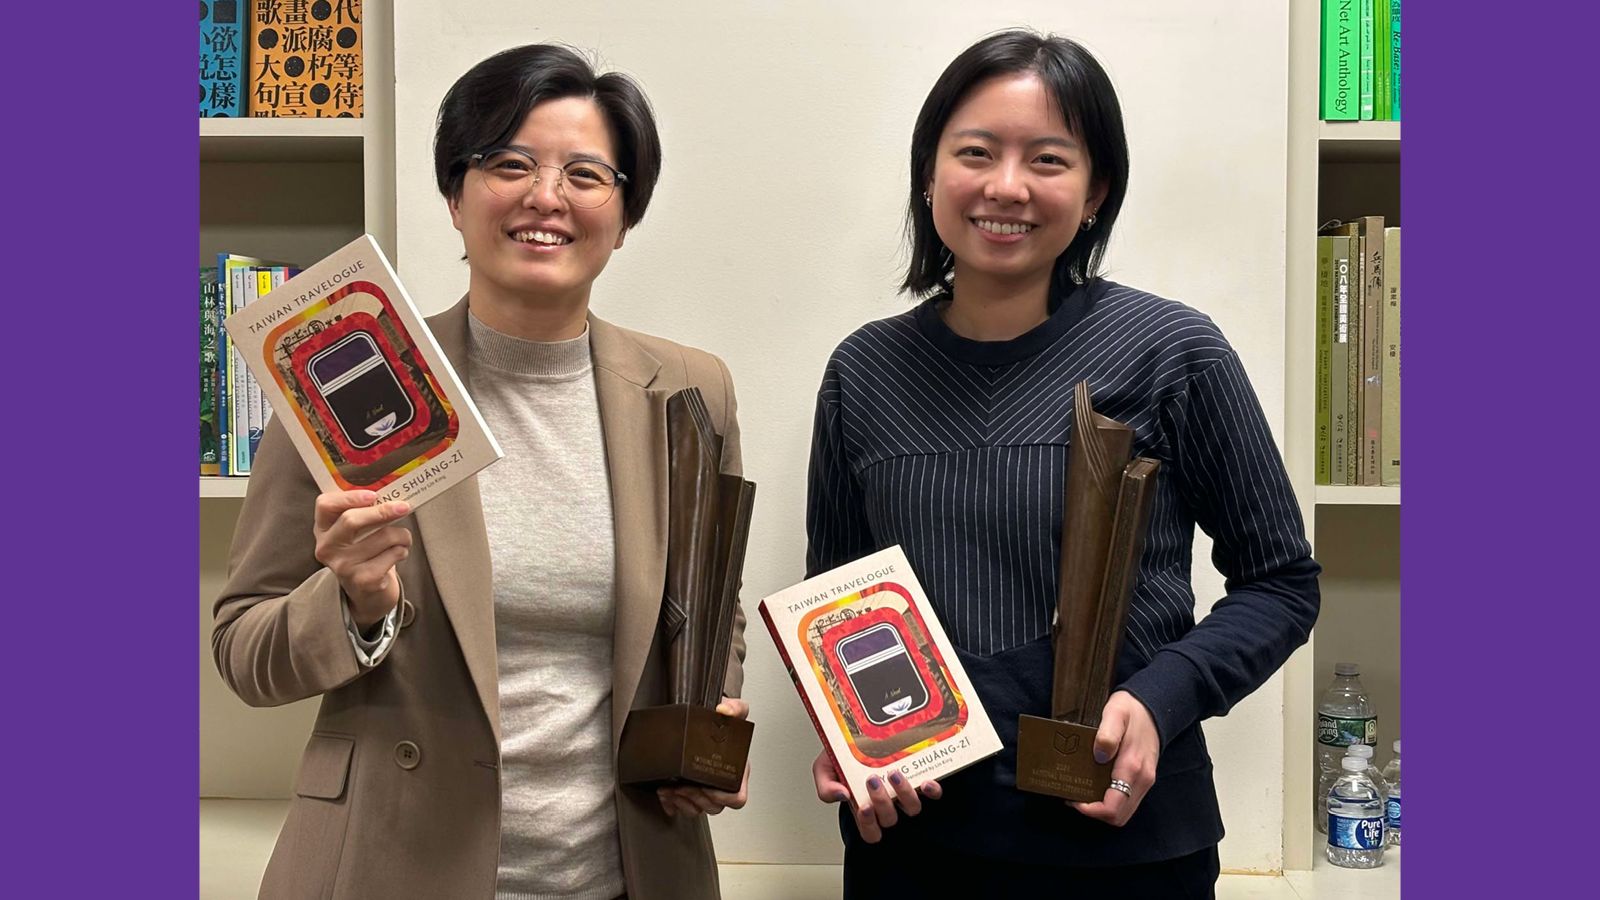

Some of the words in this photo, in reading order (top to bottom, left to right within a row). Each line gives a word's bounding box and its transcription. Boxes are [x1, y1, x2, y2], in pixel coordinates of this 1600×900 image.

[1340, 25, 1351, 46] Art
[1335, 49, 1351, 115] Anthology
[248, 304, 292, 334] TAIWAN
[293, 259, 366, 307] TRAVELOGUE
[788, 591, 829, 613] TAIWAN
[830, 564, 896, 596] TRAVELOGUE
[1361, 820, 1380, 830] Pure
[1364, 829, 1379, 840] Life
